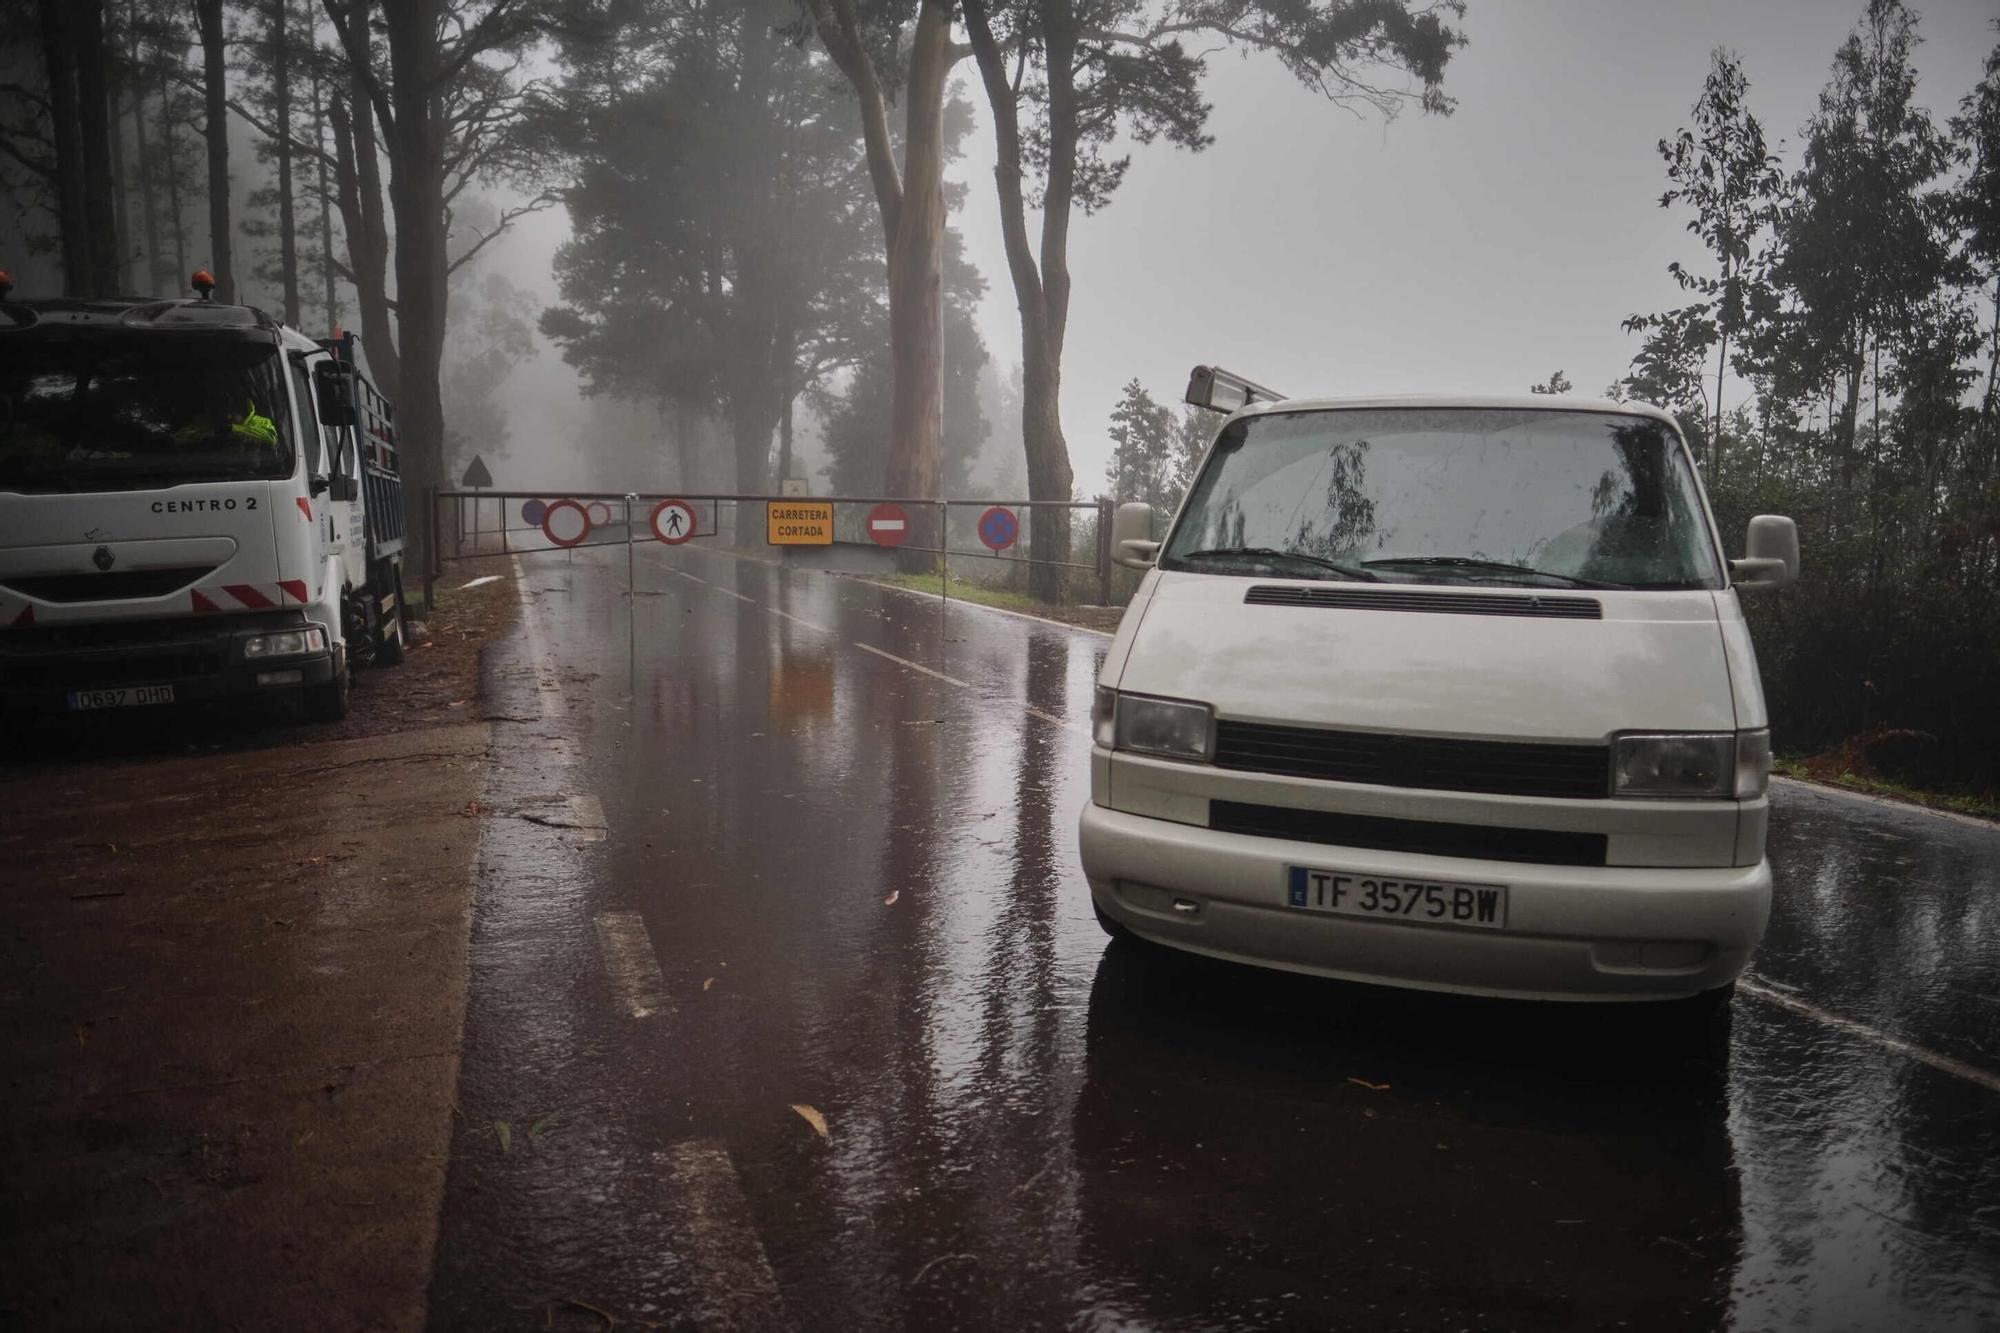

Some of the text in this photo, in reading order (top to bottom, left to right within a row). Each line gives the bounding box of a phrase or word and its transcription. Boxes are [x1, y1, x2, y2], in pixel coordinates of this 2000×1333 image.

[151, 497, 257, 513] CENTRO 2
[772, 509, 828, 520] CARRETERA
[778, 526, 823, 536] CORTADA
